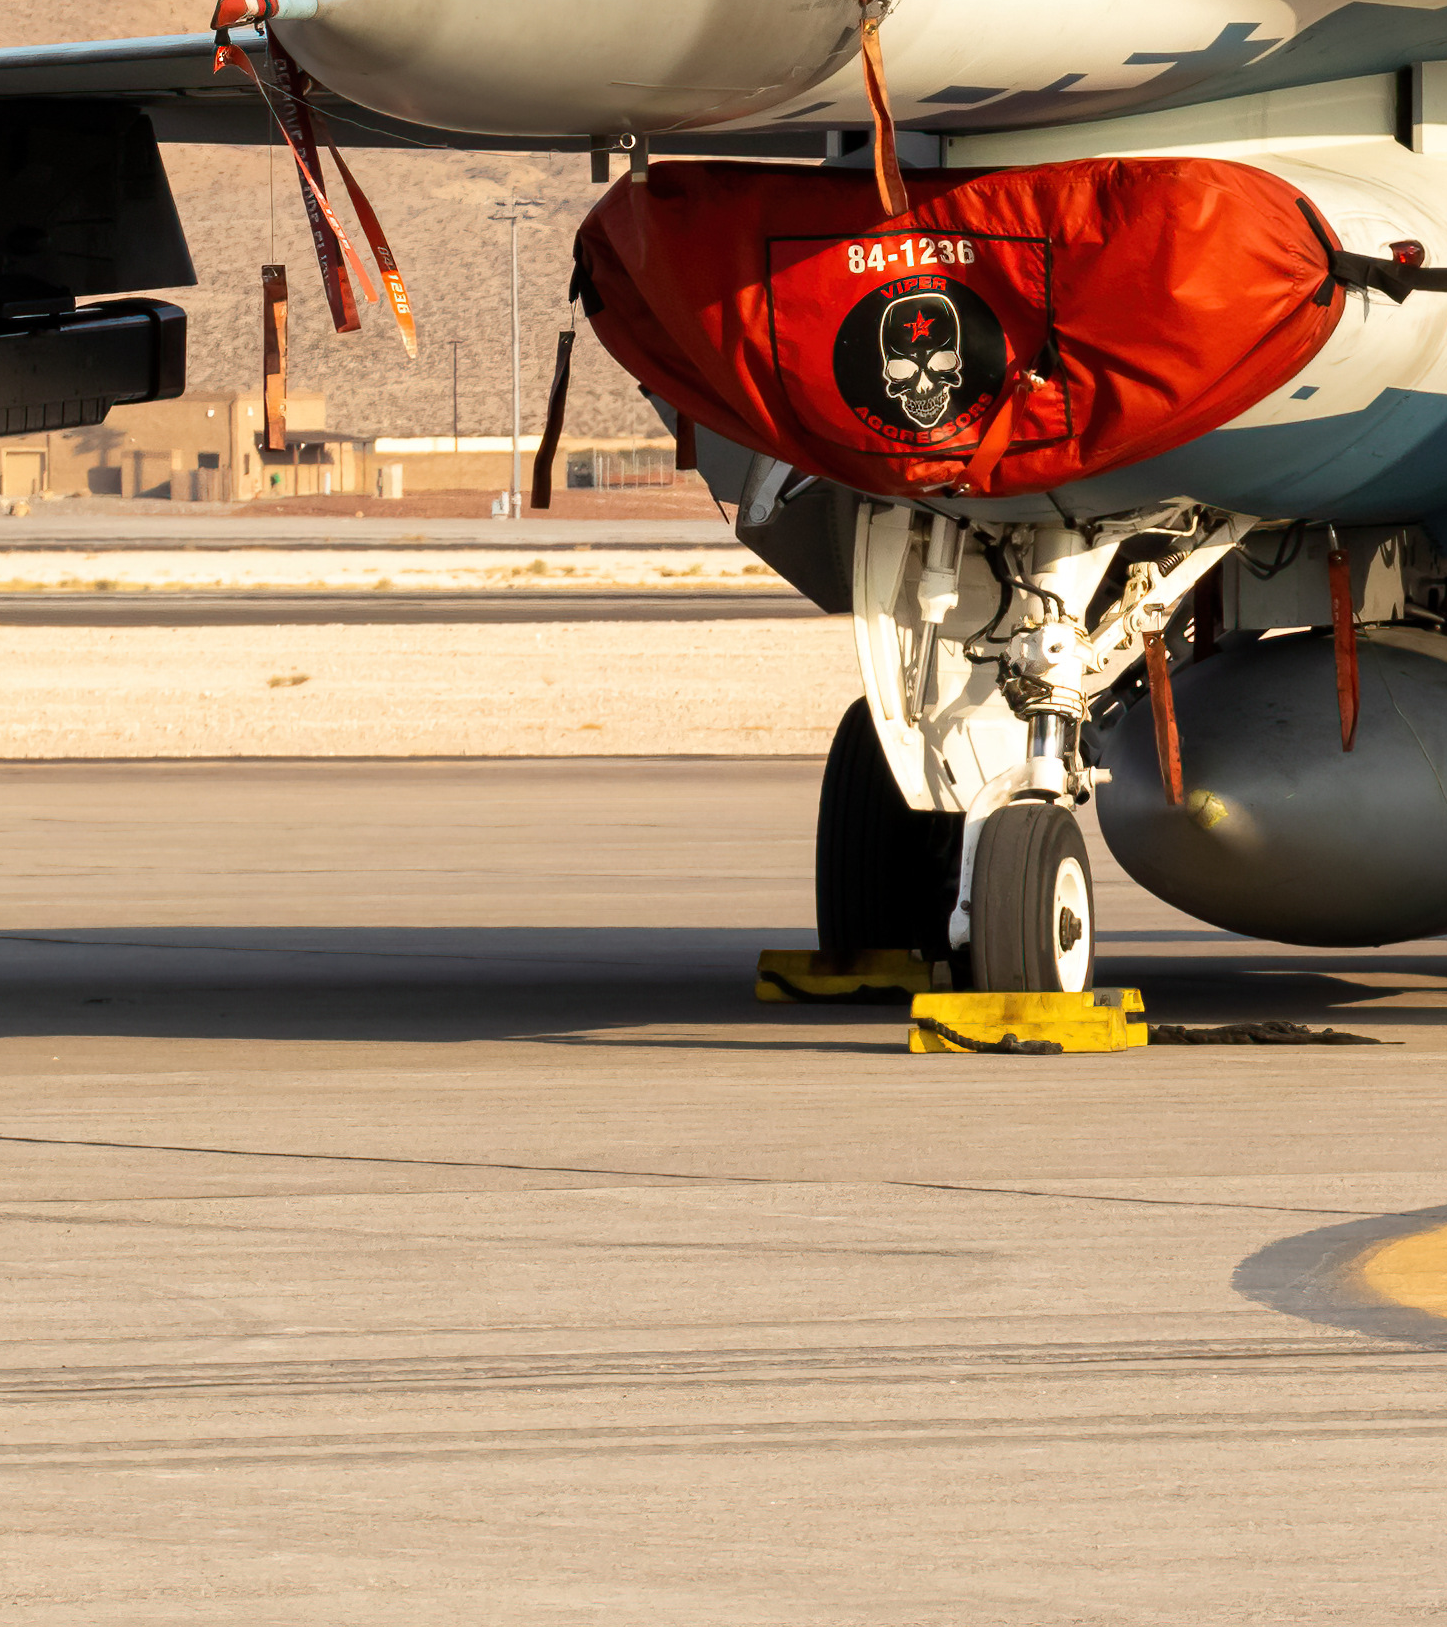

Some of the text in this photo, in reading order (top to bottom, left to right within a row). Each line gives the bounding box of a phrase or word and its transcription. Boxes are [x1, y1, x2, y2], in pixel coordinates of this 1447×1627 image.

[847, 237, 975, 274] 84-1236
[879, 275, 948, 299] VIPER
[853, 392, 994, 444] AGGRESSORS
